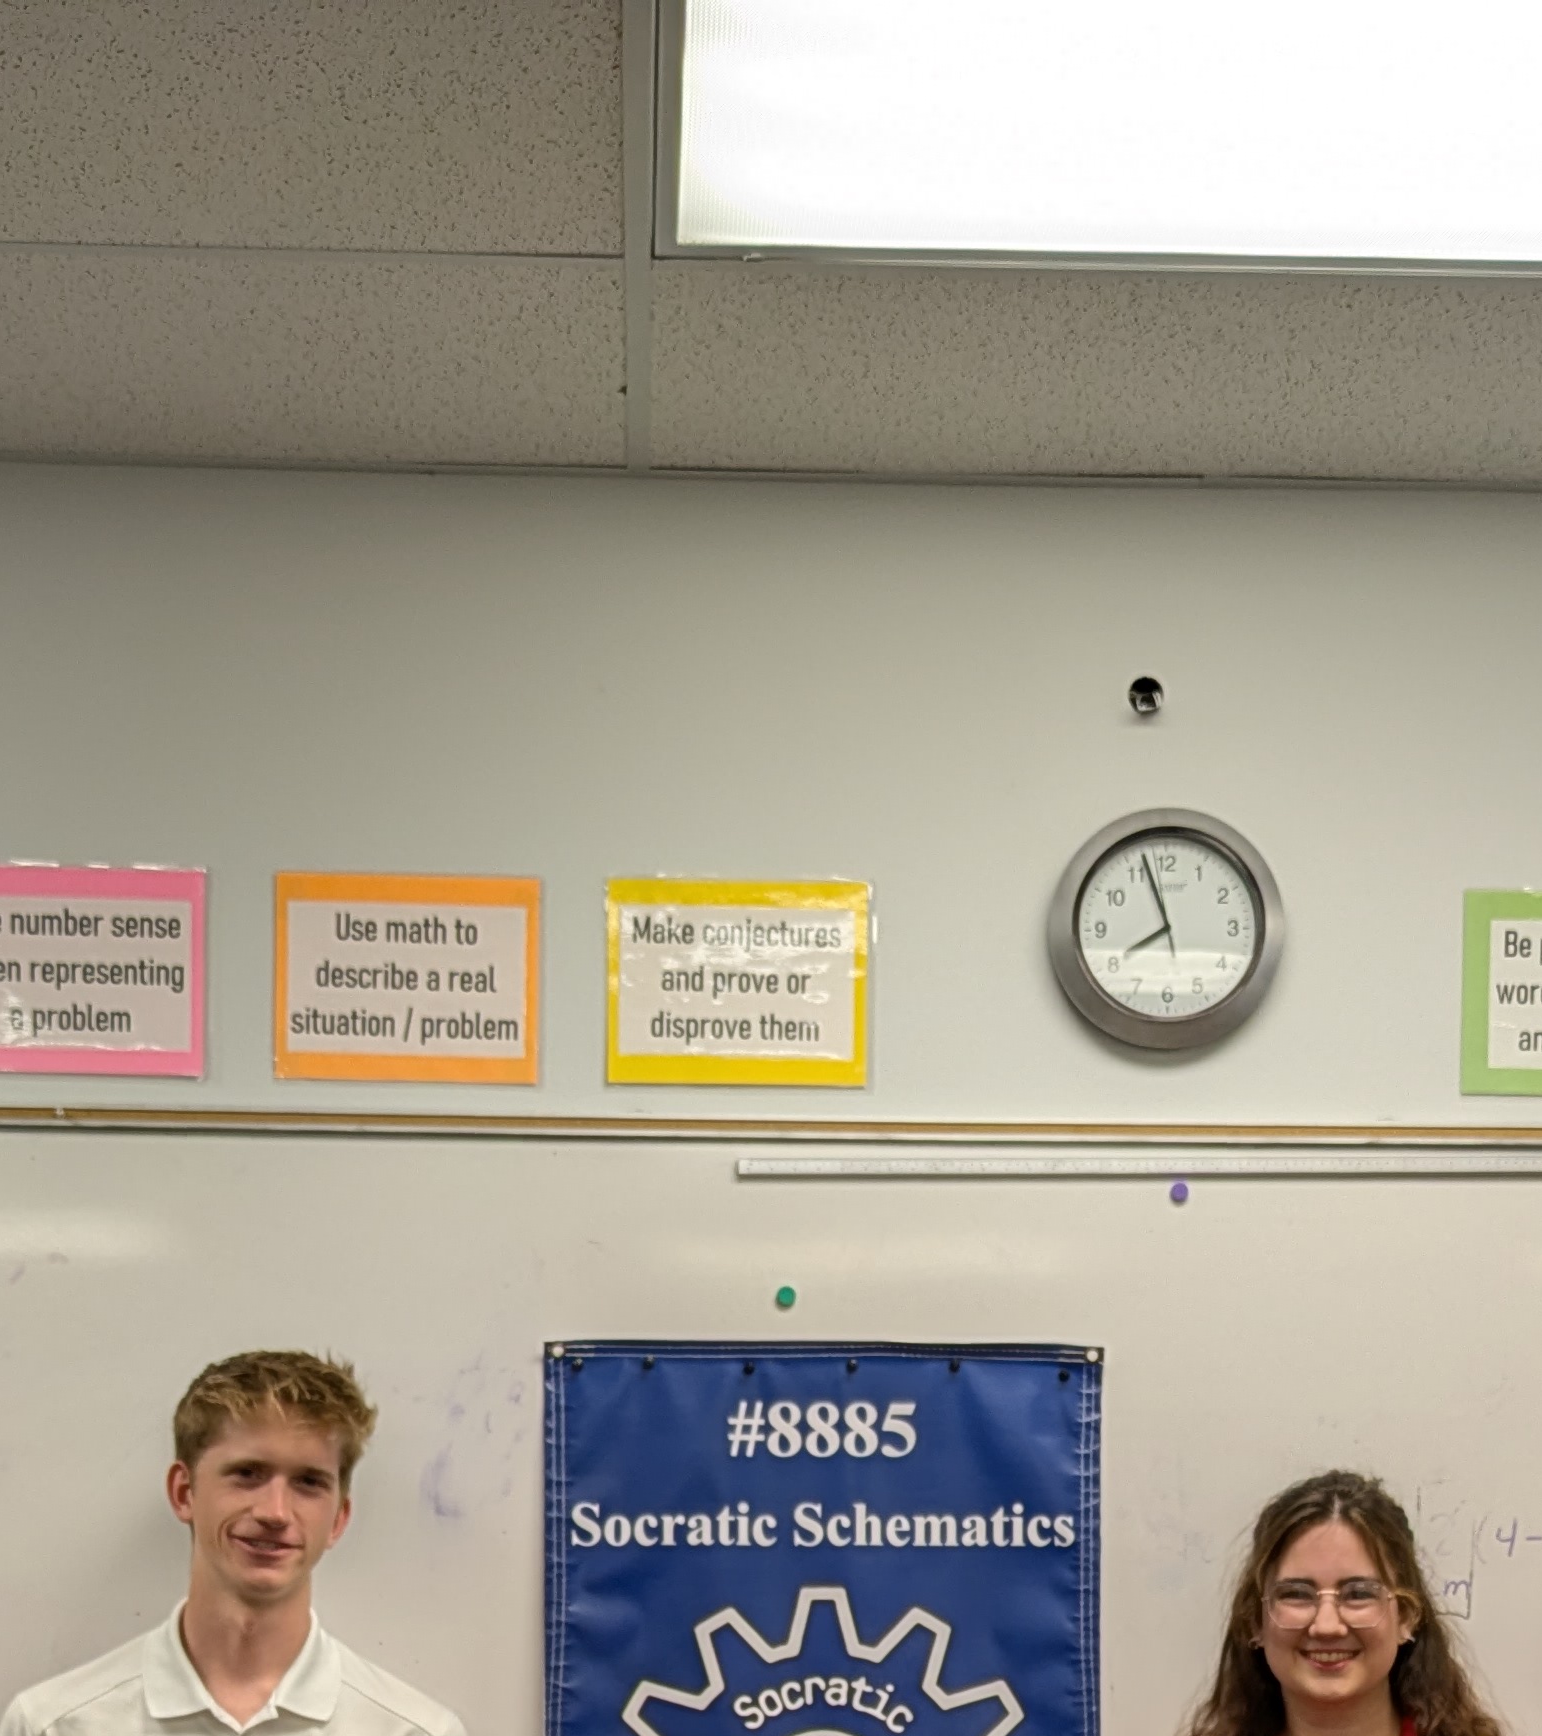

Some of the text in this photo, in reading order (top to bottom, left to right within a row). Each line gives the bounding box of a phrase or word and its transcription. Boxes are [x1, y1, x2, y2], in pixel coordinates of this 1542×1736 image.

[1129, 867, 1146, 883] 11
[1158, 855, 1176, 873] 12
[1195, 865, 1203, 882] 1
[1106, 890, 1125, 907] 10
[1217, 888, 1229, 905] 2
[10, 909, 102, 937] number
[110, 916, 182, 939] sense
[335, 913, 479, 946] Use math to
[633, 917, 842, 953] Make conjectures
[1094, 922, 1107, 938] 9
[1227, 920, 1239, 937] 3
[1504, 930, 1533, 959] Be
[29, 960, 185, 994] representing
[315, 961, 496, 993] describe a real
[1108, 957, 1120, 974] 8
[1216, 956, 1227, 970] 4
[661, 966, 811, 1000] and prove or
[1131, 978, 1142, 995] 7
[1161, 986, 1173, 1003] 6
[1192, 978, 1204, 994] 5
[31, 1004, 132, 1037] problem
[290, 1007, 520, 1043] situation / problem
[651, 1012, 820, 1046] disprove them
[727, 1400, 917, 1459] #8885
[570, 1502, 1076, 1549] Socratic Schematics
[733, 1674, 914, 1734] Socratic
